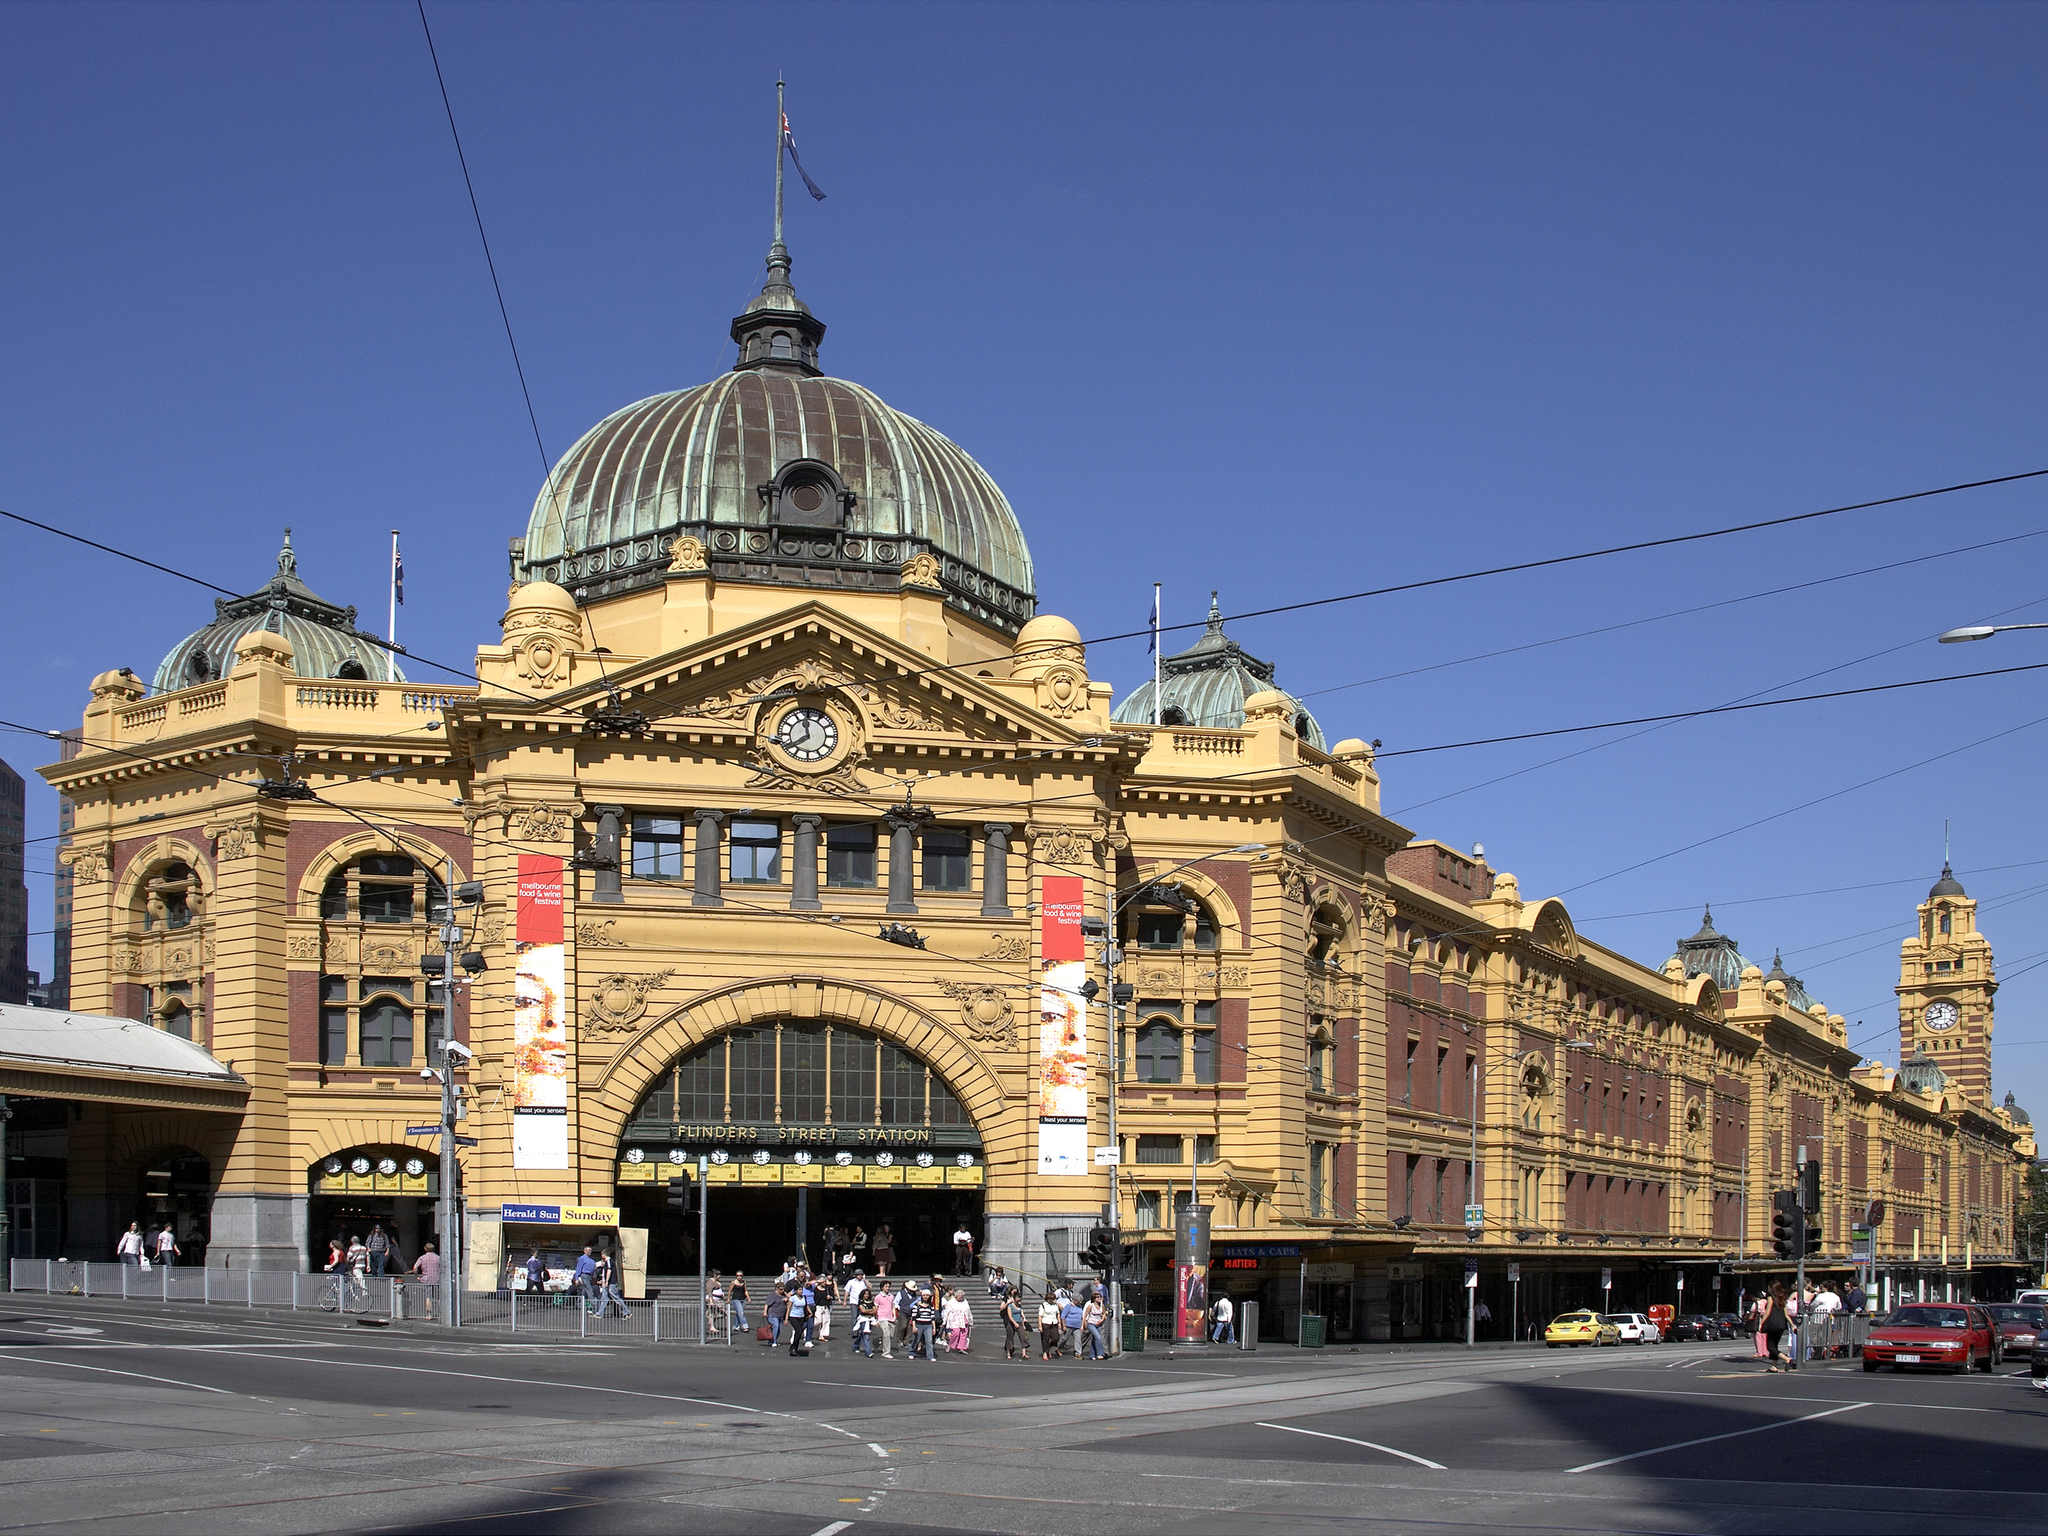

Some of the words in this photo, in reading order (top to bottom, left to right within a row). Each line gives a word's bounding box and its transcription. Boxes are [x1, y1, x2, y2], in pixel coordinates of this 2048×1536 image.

[521, 882, 561, 890] melbourne
[519, 889, 535, 897] food
[534, 897, 561, 906] festival
[1057, 917, 1082, 925] festival
[678, 1125, 758, 1139] FLINDERS
[778, 1127, 838, 1140] STREET
[858, 1128, 930, 1142] STATION
[503, 1208, 537, 1218] Herald
[539, 1210, 559, 1219] Sun
[564, 1210, 615, 1224] Sunday
